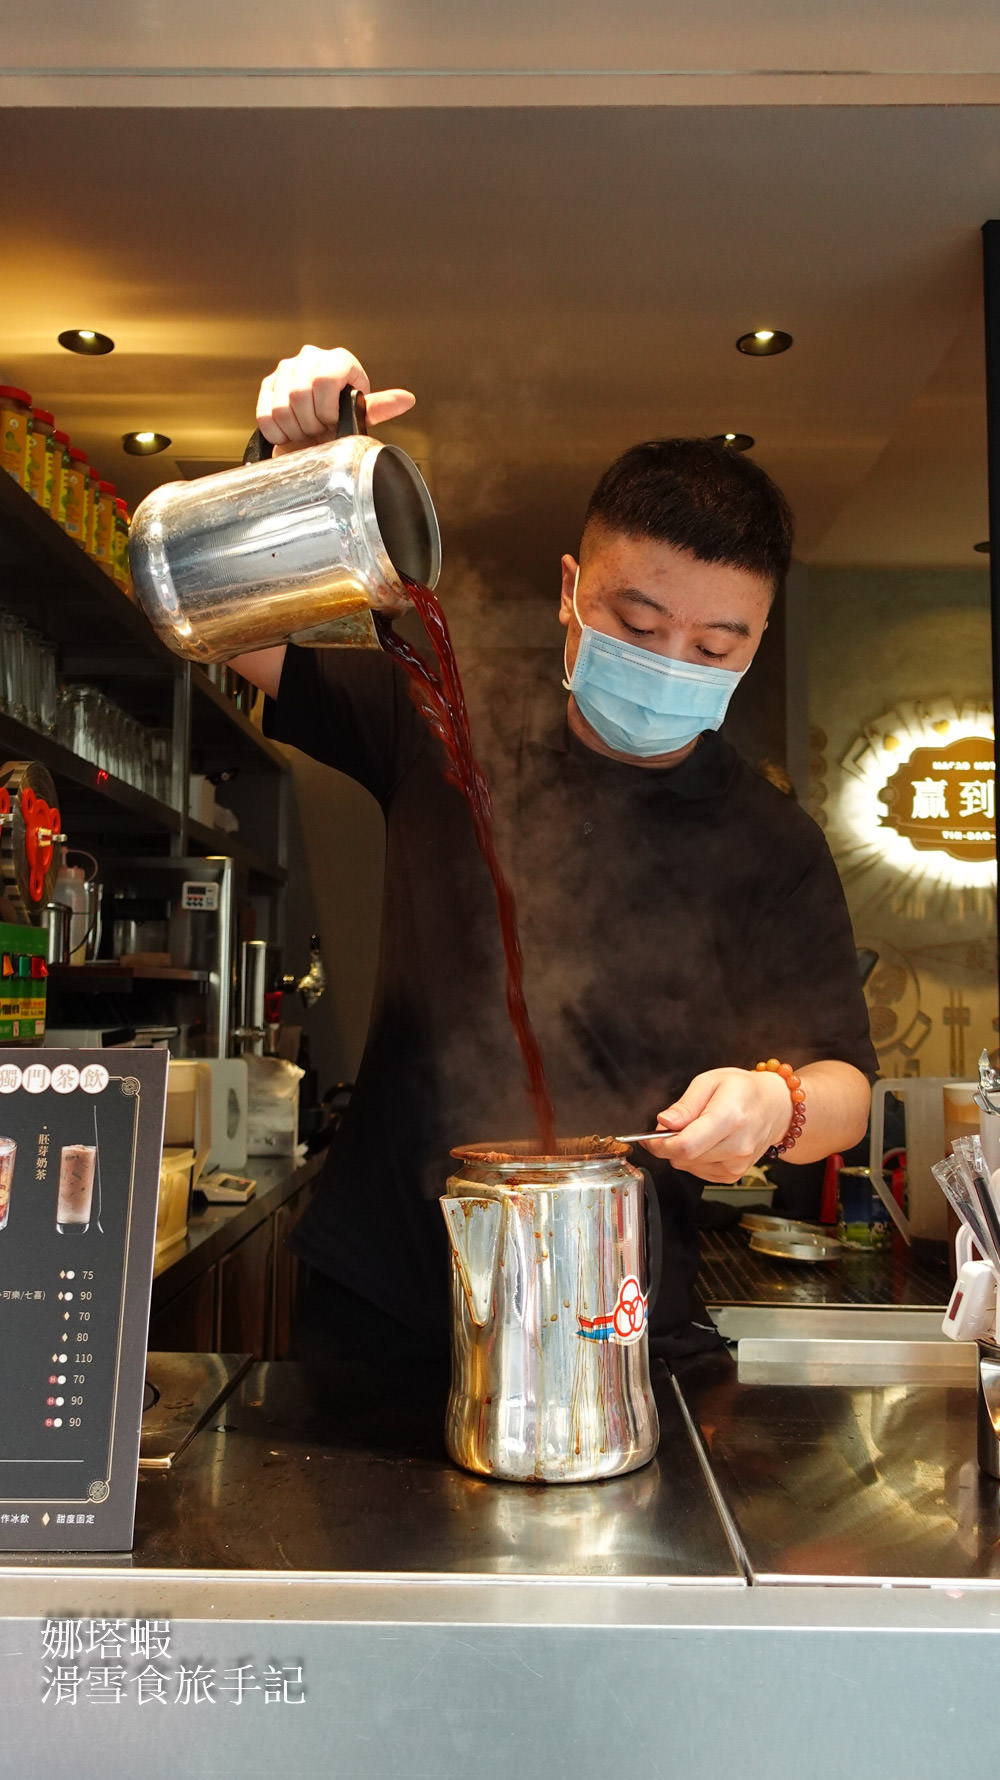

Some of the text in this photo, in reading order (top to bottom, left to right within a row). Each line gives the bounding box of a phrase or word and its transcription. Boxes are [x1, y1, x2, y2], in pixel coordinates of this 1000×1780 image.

[82, 1270, 94, 1280] 75
[80, 1291, 92, 1301] 90
[79, 1311, 91, 1321] 70
[76, 1332, 89, 1342] 80
[75, 1353, 93, 1363] 110
[73, 1374, 85, 1384] 70
[71, 1395, 83, 1406] 90
[69, 1417, 82, 1427] 90
[56, 1513, 95, 1524] 甜度固定
